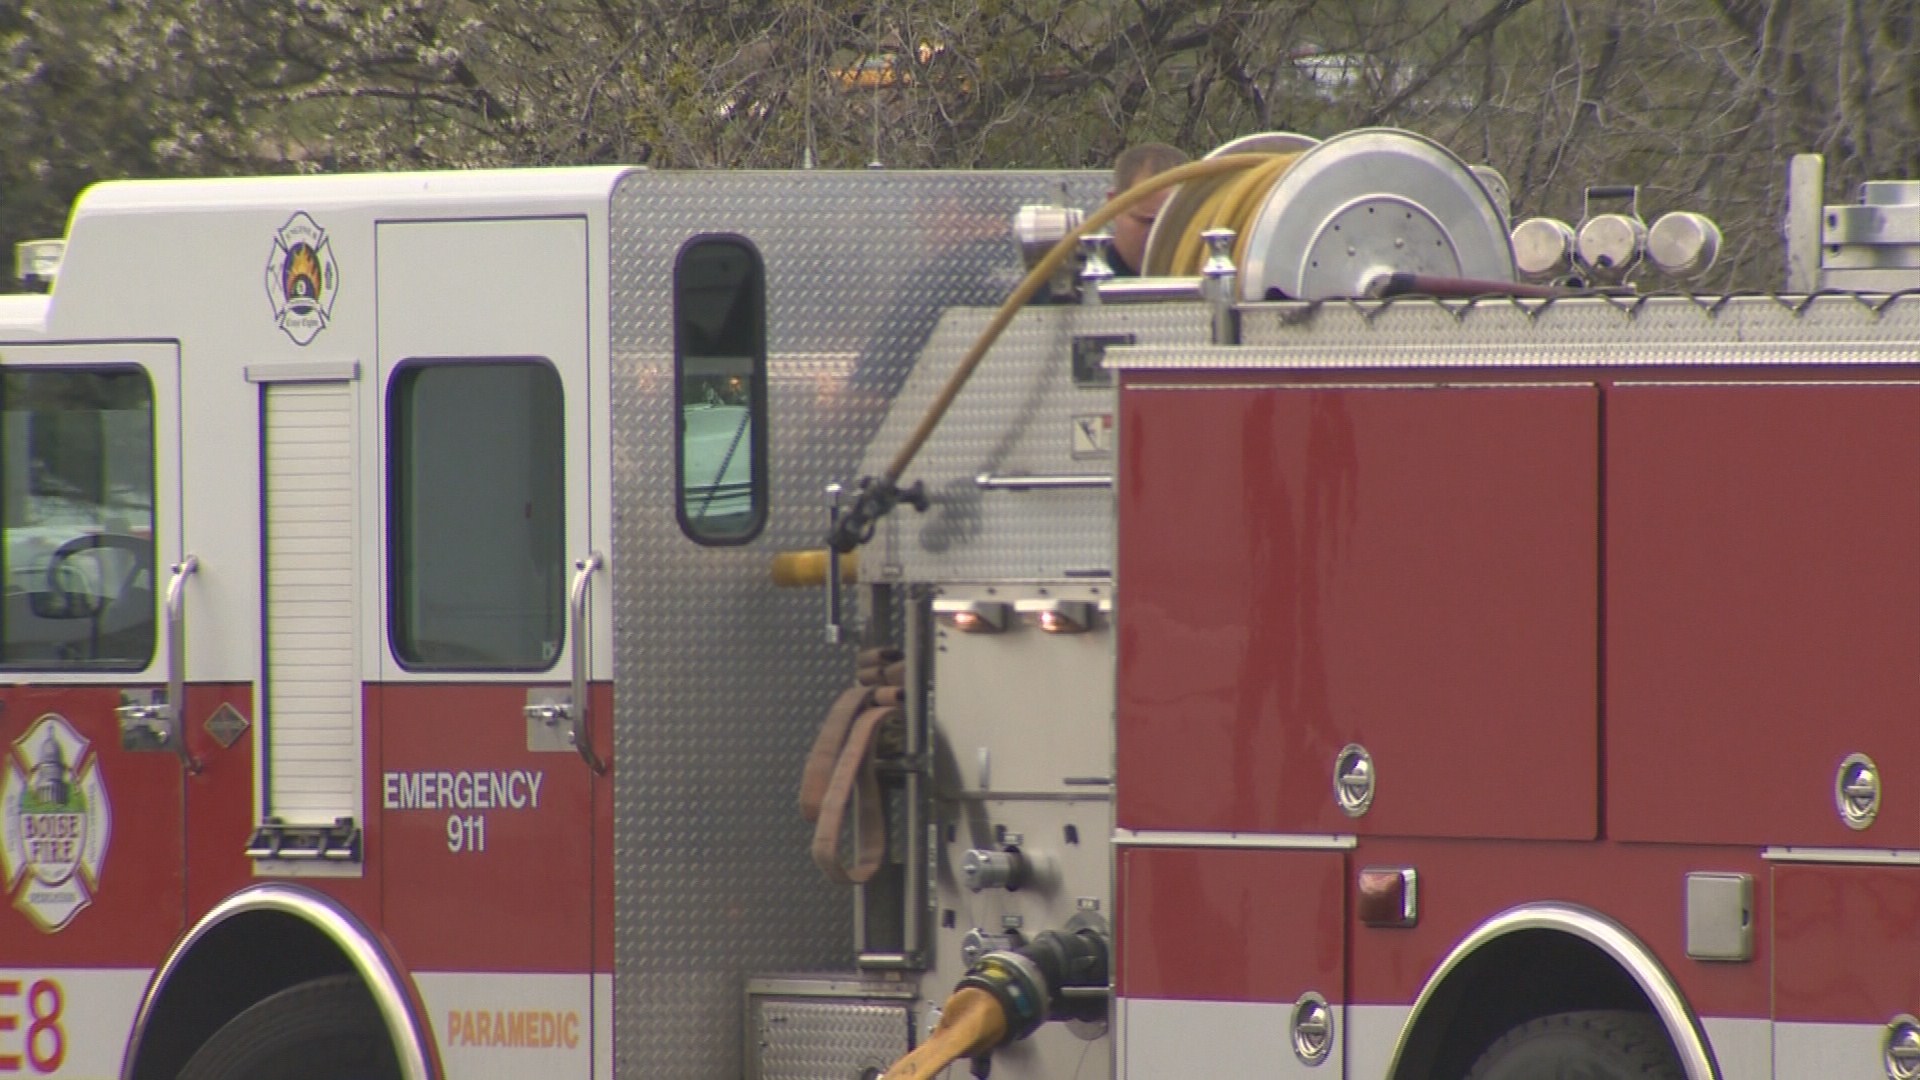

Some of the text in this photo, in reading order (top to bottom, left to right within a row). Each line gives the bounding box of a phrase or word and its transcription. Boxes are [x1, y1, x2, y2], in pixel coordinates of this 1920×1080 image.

[383, 770, 543, 809] EMERGENCY
[25, 815, 79, 838] BOISE
[447, 814, 485, 852] 911
[31, 841, 74, 863] FIRE
[447, 1010, 579, 1049] PARAMEDIC
